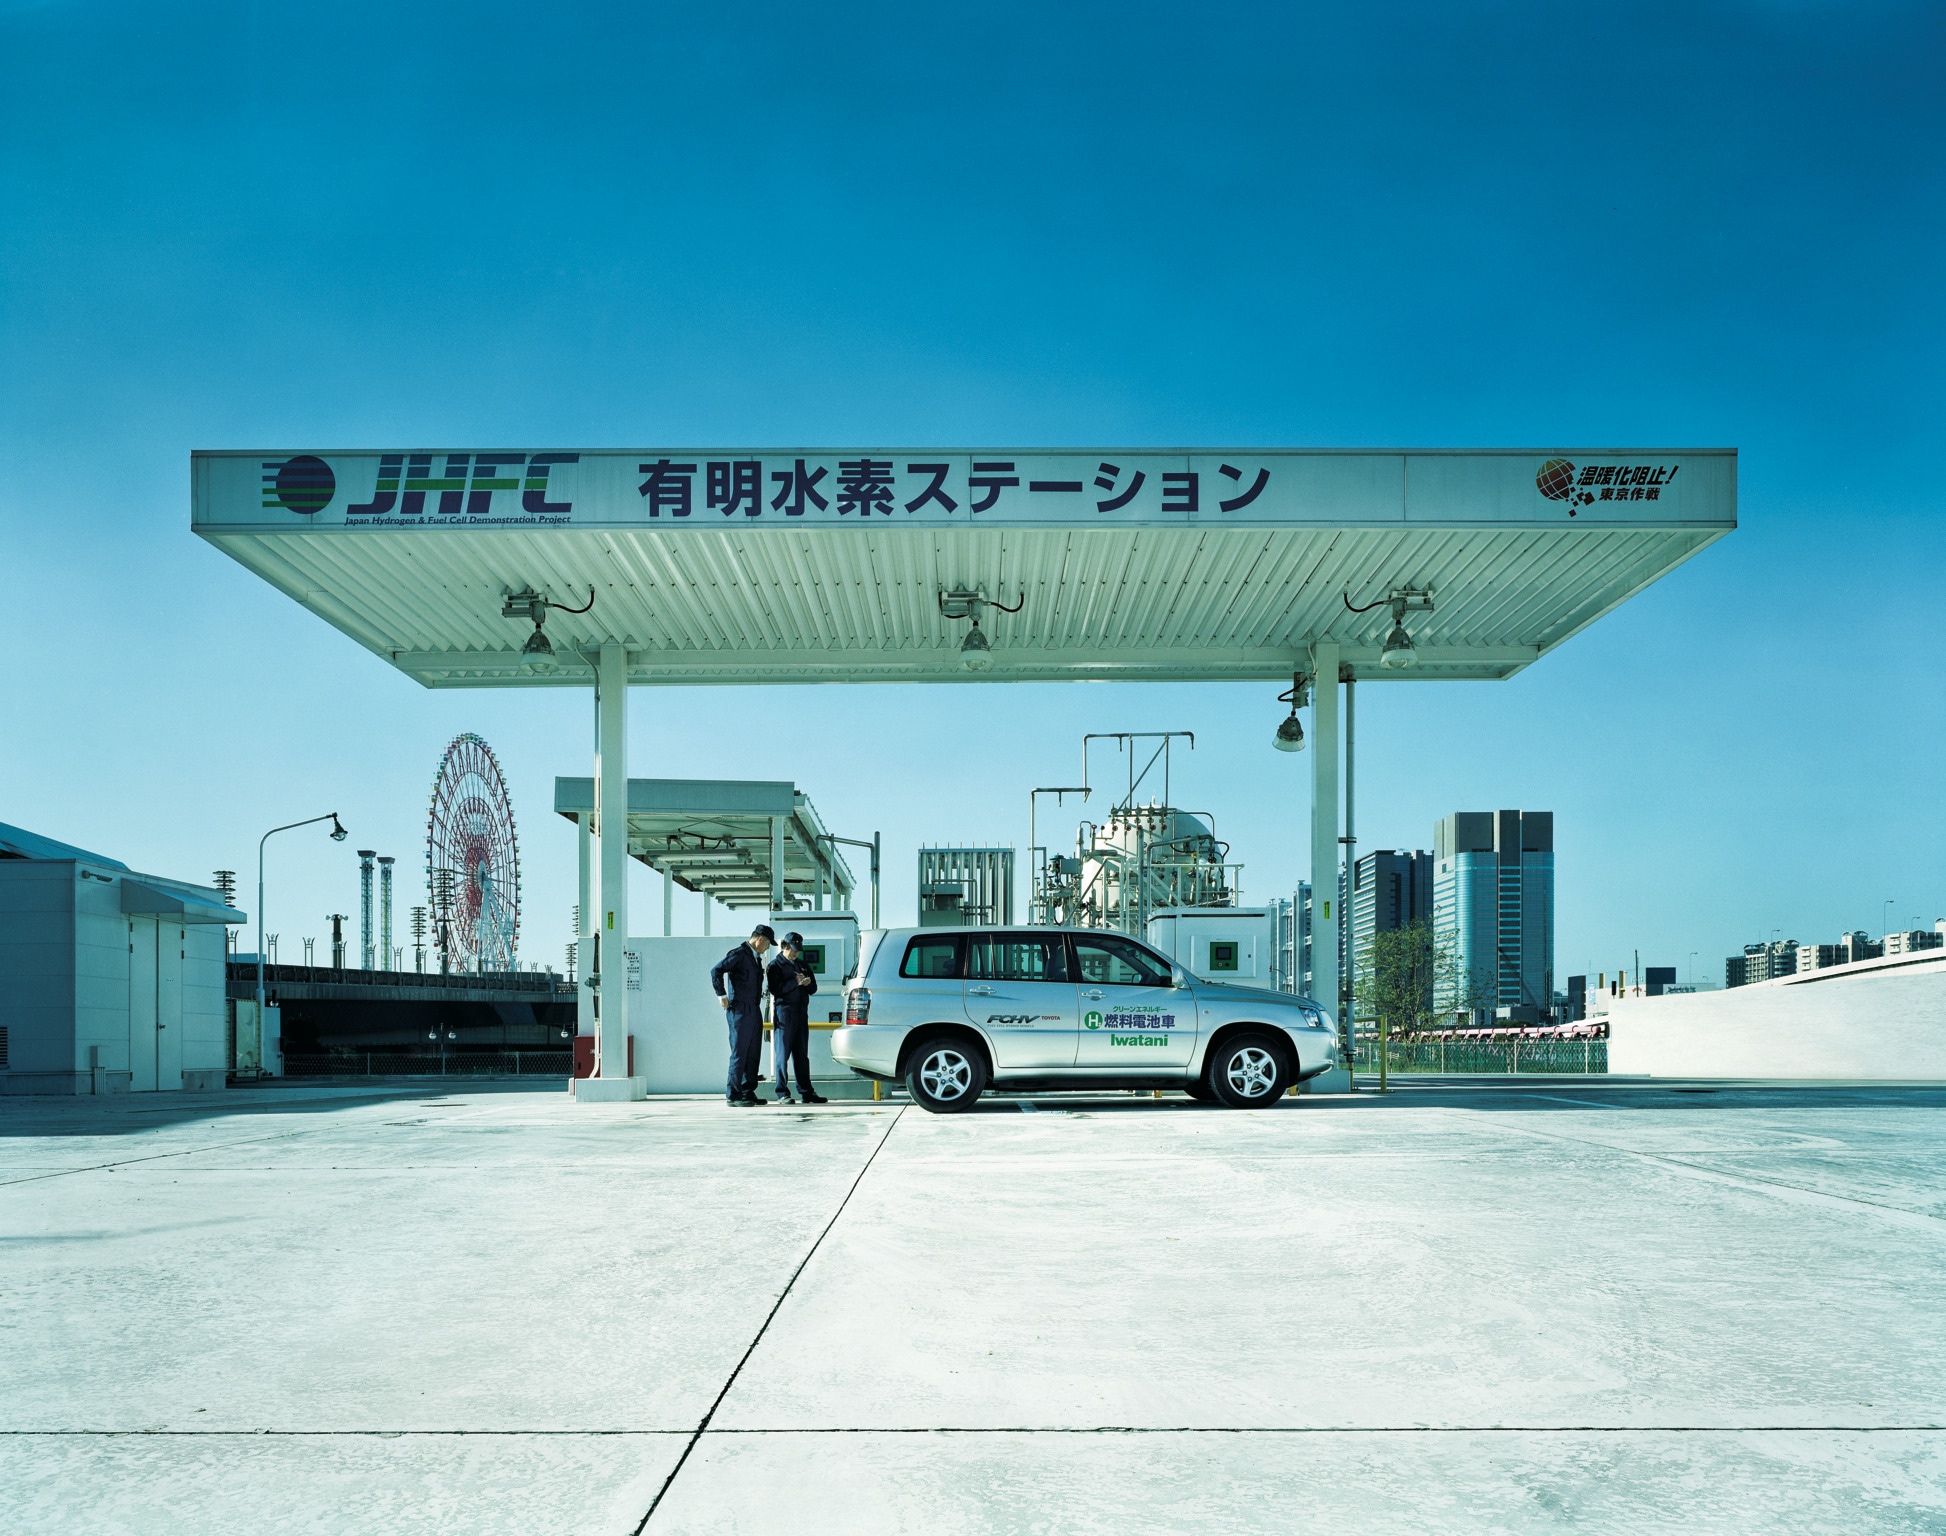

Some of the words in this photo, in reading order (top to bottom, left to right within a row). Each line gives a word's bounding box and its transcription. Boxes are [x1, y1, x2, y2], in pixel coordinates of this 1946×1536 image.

[1576, 465, 1679, 486] 温暖化阻止!
[347, 453, 580, 514] JHFC
[638, 459, 1271, 517] 有明水素ステーション
[1599, 487, 1660, 501] 東京作戦
[344, 516, 370, 526] Japan
[372, 516, 416, 526] Hydrogen
[418, 516, 425, 524] &
[427, 516, 447, 524] Fuel
[449, 516, 467, 524] Cell
[469, 515, 536, 524] Demonstration
[538, 515, 571, 524] Project
[987, 1015, 1040, 1024] FCHV
[1104, 1013, 1175, 1029] 燃料電池車
[1111, 1034, 1168, 1046] Iwatani
